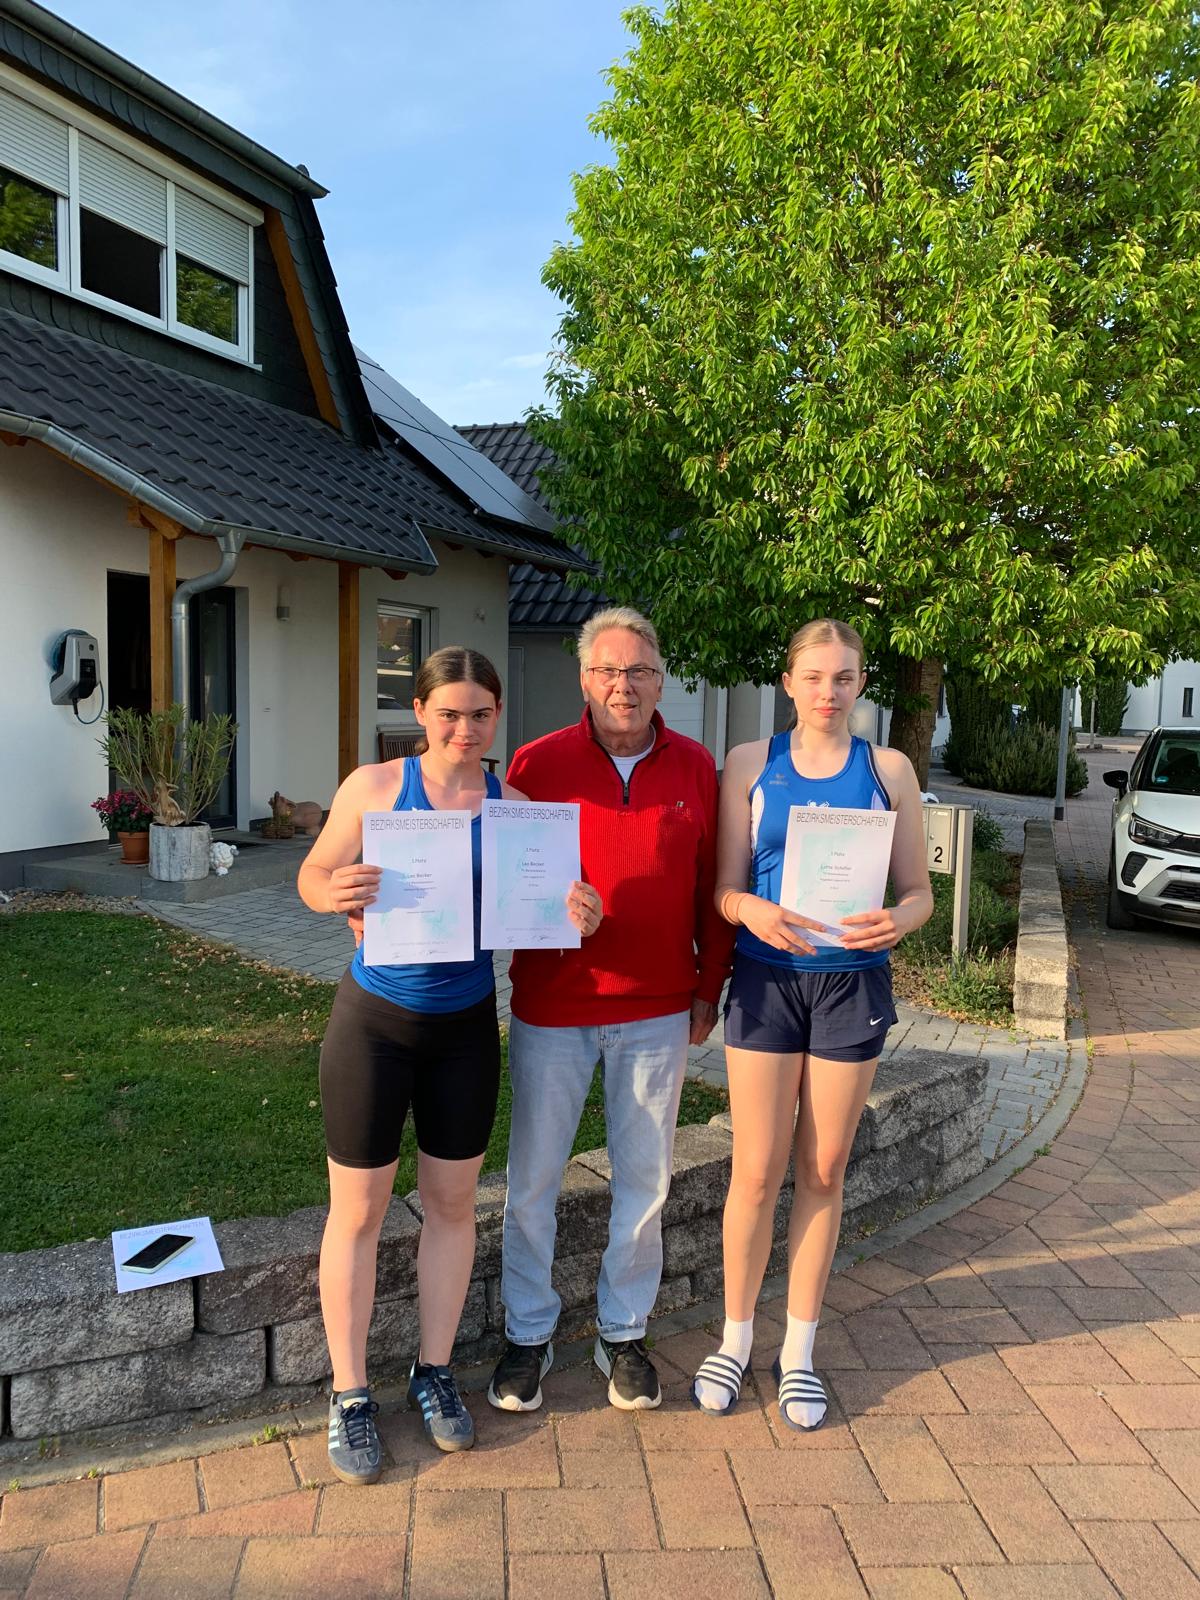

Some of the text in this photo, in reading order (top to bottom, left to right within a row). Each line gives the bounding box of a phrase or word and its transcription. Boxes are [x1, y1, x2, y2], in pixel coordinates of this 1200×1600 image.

[489, 806, 574, 820] BEZIRKSMEISTERSCHAFTEN
[796, 812, 888, 827] BEZIRKSMEISTERSCHAFTEN
[370, 817, 464, 831] BEZIRKSMEISTERSCHAFTEN
[933, 846, 943, 864] 2
